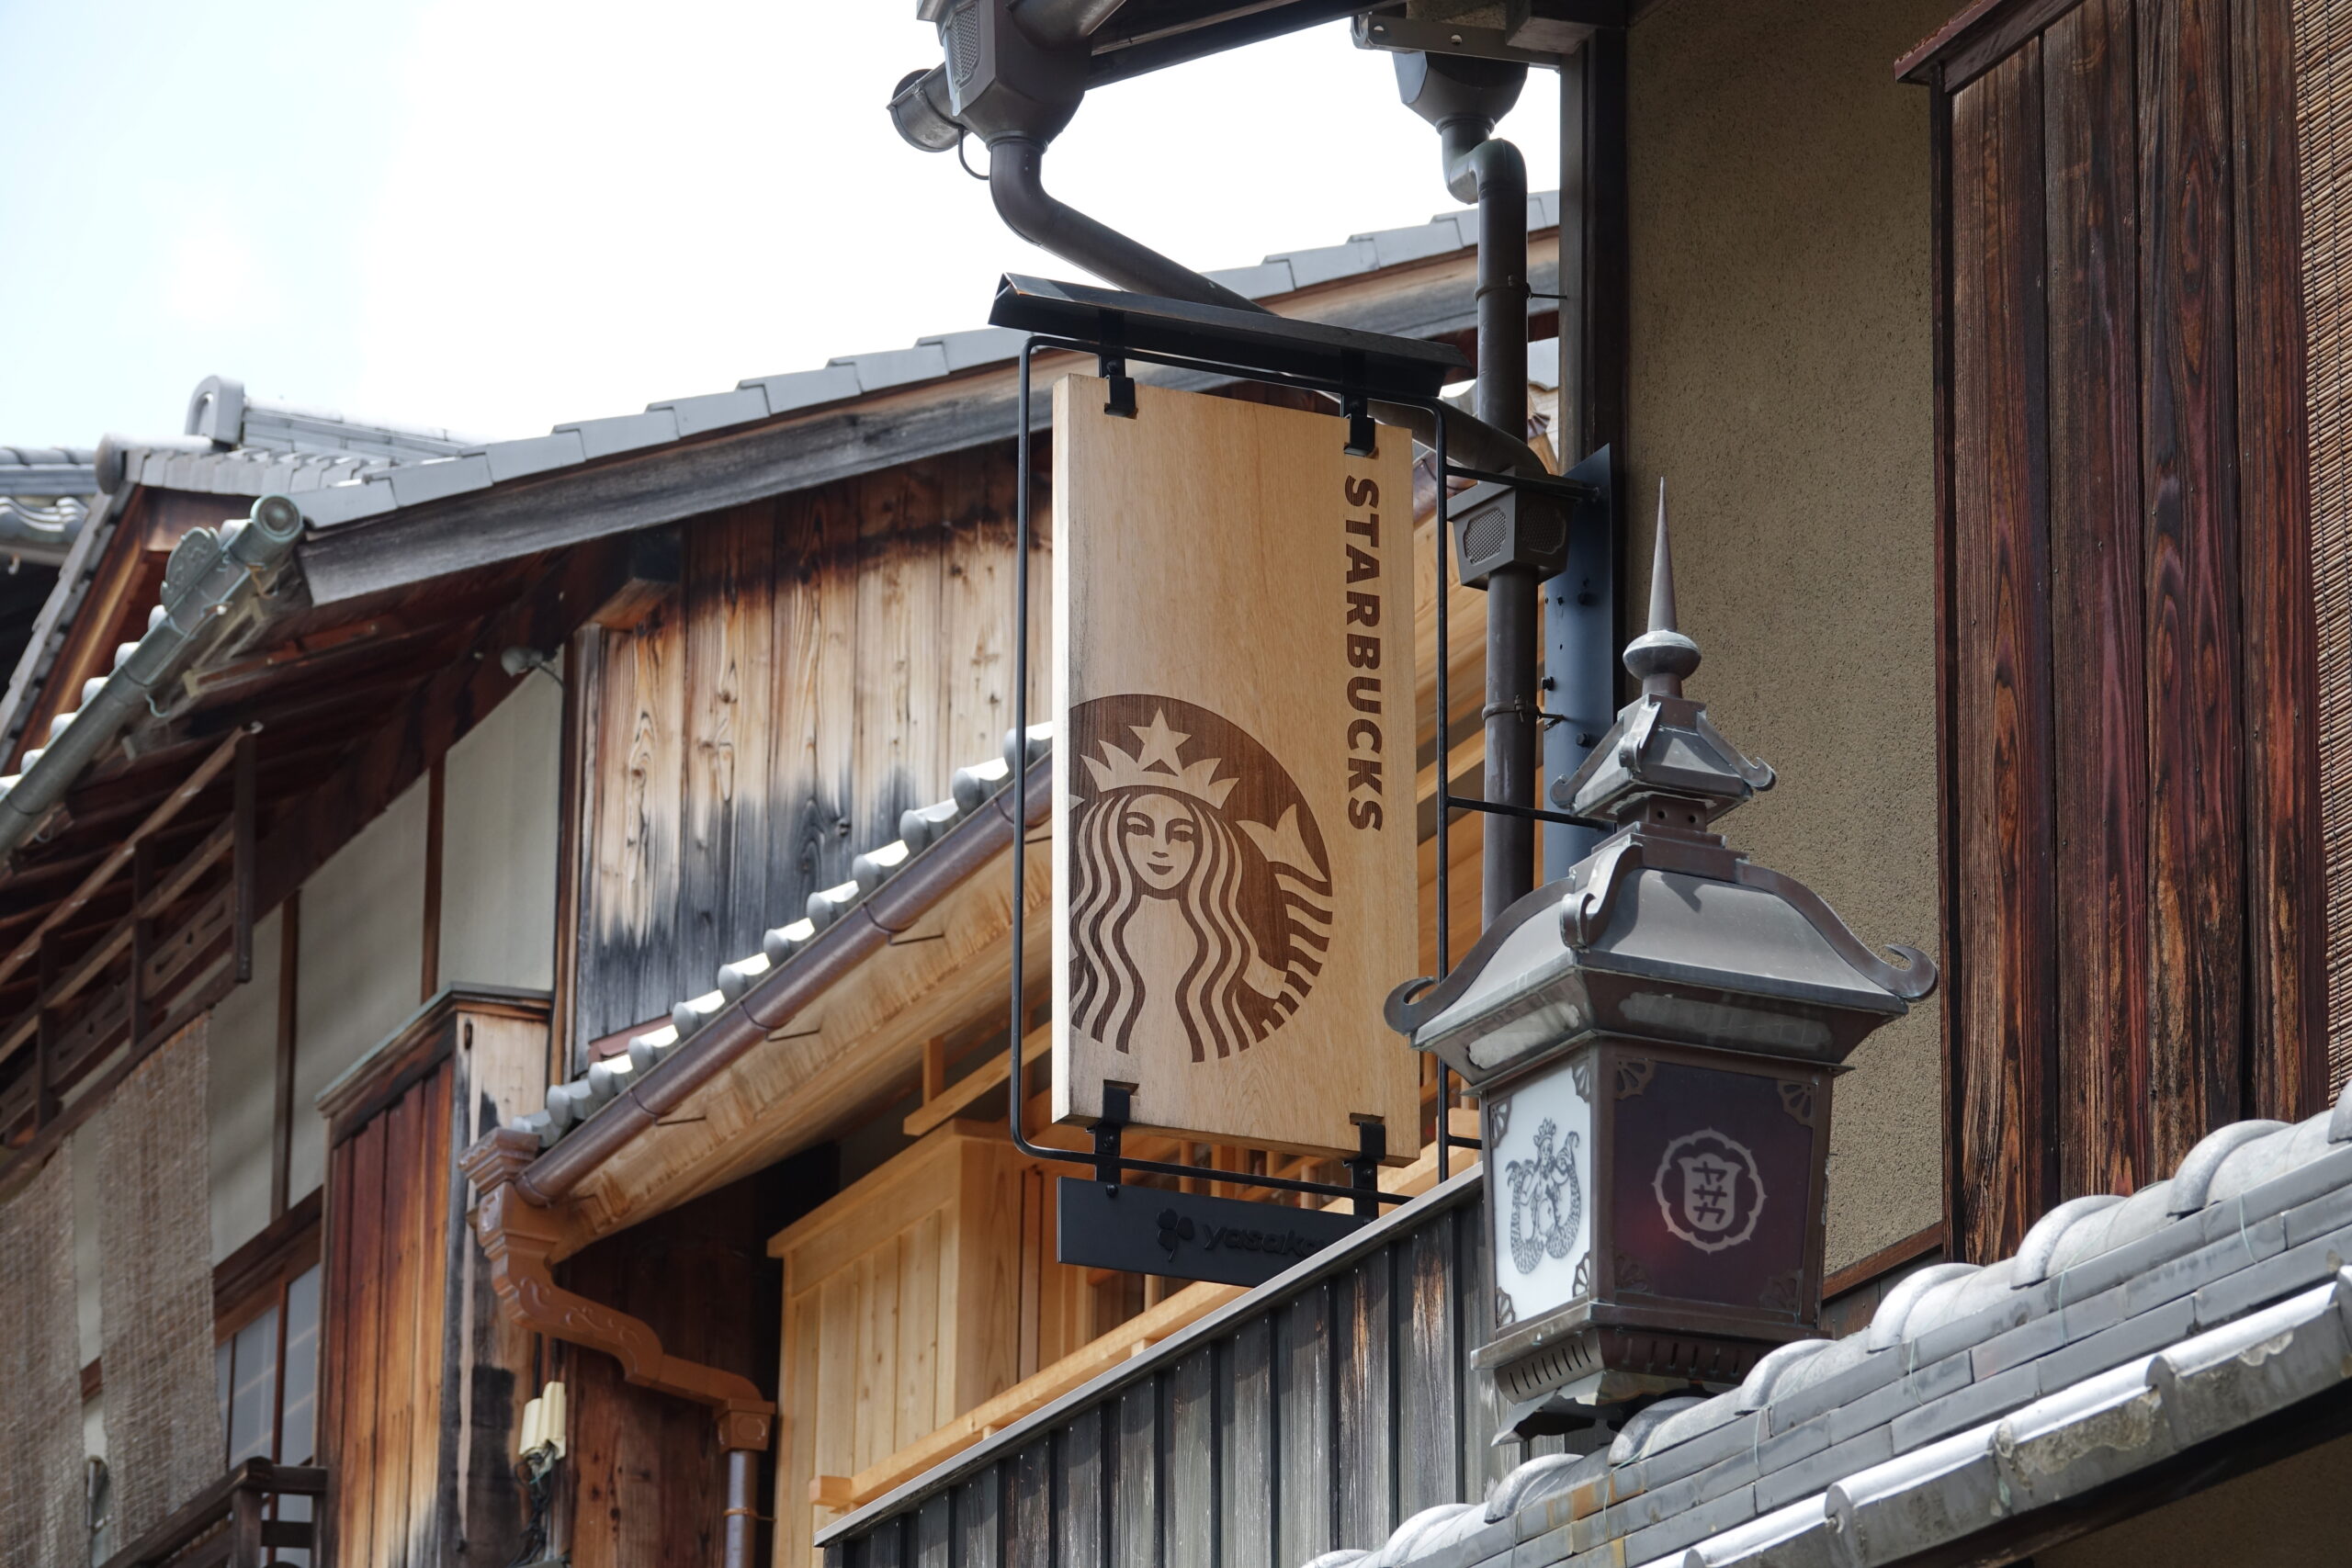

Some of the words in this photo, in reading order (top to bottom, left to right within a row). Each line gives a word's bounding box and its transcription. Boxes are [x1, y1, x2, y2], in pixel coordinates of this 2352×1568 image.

[1344, 474, 1384, 832] STARBUCKS
[1691, 1160, 1728, 1225] ヤサカ
